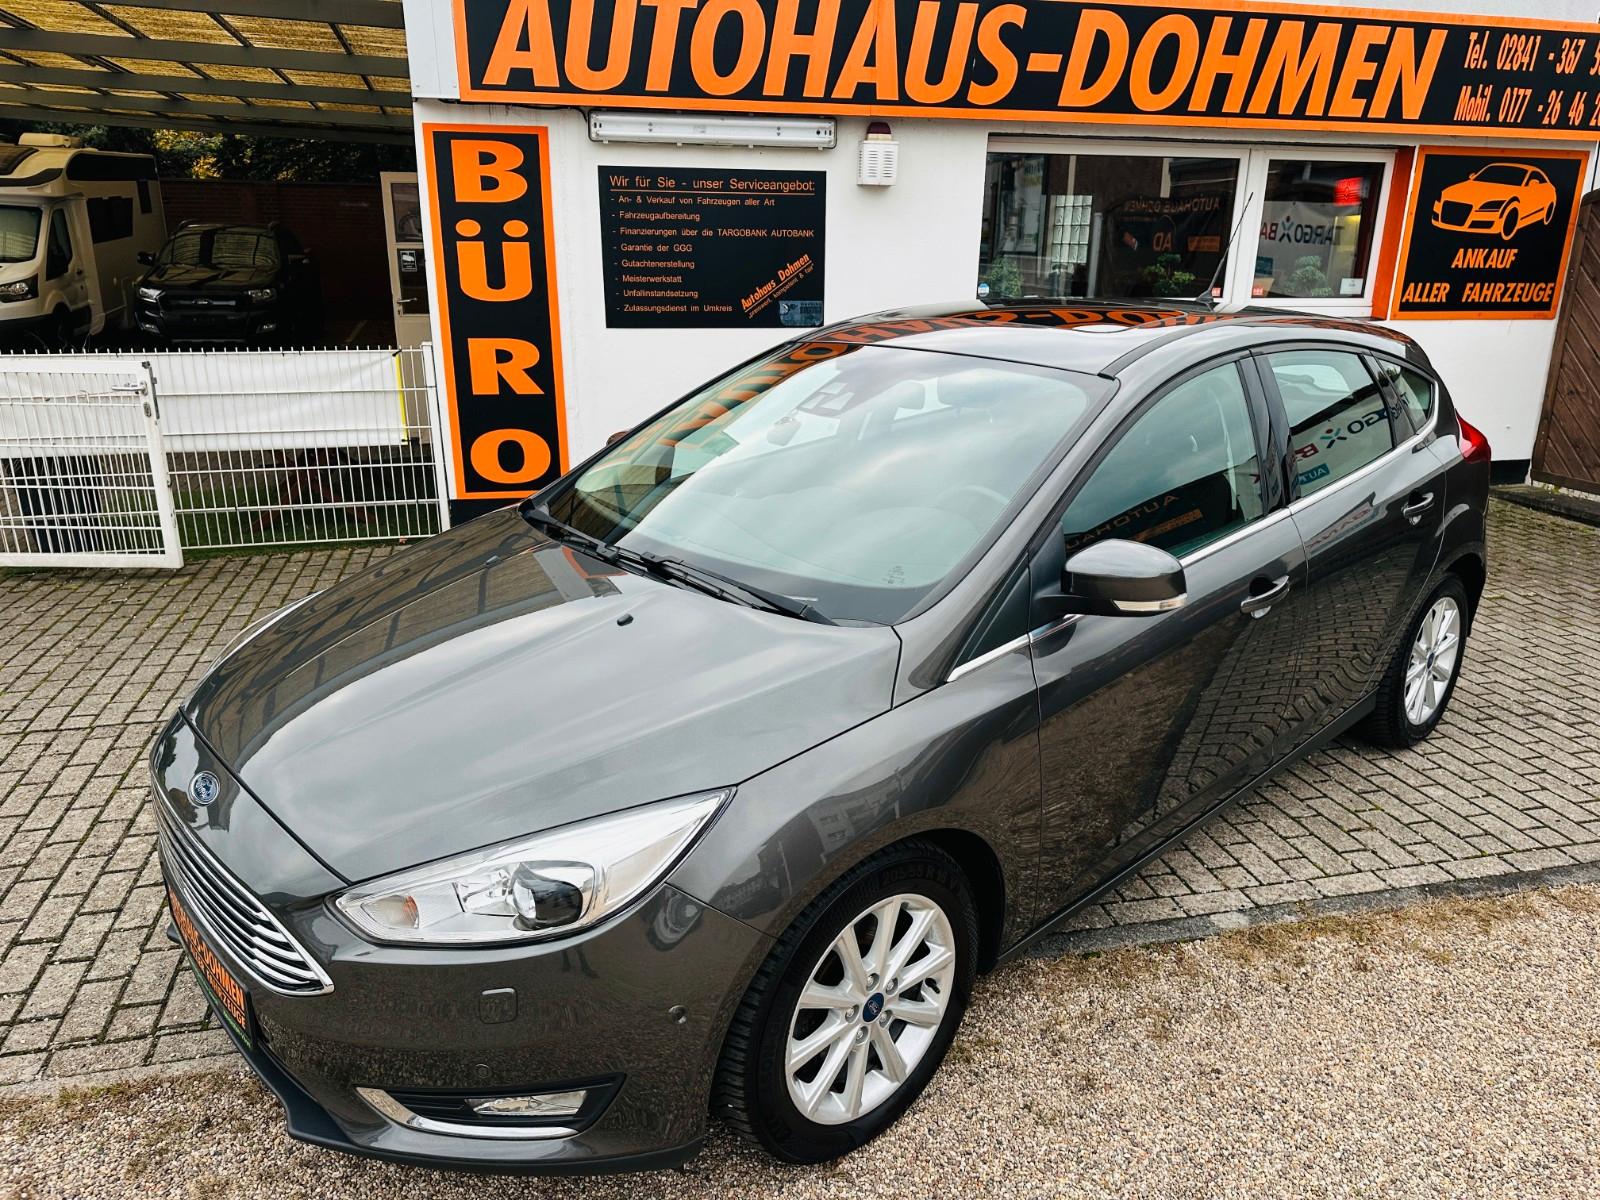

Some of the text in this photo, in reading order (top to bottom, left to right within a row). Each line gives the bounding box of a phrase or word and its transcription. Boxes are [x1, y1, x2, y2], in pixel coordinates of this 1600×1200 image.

[482, 0, 1447, 119] AUTOHAUS-DOHMEN
[1463, 31, 1490, 69] Tel.
[1496, 33, 1541, 72] 02841
[1589, 40, 1600, 76] 5
[1454, 84, 1493, 122] Mobil.
[1498, 87, 1532, 123] 0177
[1568, 91, 1588, 126] 46
[1589, 92, 1600, 126] 2
[610, 175, 630, 188] Wir
[635, 175, 650, 188] für
[657, 176, 676, 189] Sie
[692, 179, 724, 190] unser
[729, 177, 815, 192] Serviceangebot:
[636, 196, 643, 204] &
[646, 196, 676, 204] Verkauf
[697, 197, 741, 207] Fahrzeugen
[744, 198, 760, 206] aller
[619, 211, 701, 222] Fahrzeugaufbereitung
[620, 227, 677, 237] Finanzierungen
[681, 228, 698, 237] über
[702, 229, 713, 237] die
[717, 229, 767, 237] TARGOBANK
[621, 243, 693, 252] Garantie der GGG
[621, 259, 695, 270] Gutachtenerstellung
[1451, 248, 1519, 269] ANKAUF
[622, 274, 682, 283] Meisterwerkstatt
[741, 253, 810, 310] Autohaus Dohmen
[623, 289, 699, 299] Unfallinstandsetzung
[1402, 282, 1556, 303] ALLER FAHRZEUGE
[451, 139, 551, 484] BÜRO
[624, 304, 688, 314] Zulassungsdienst
